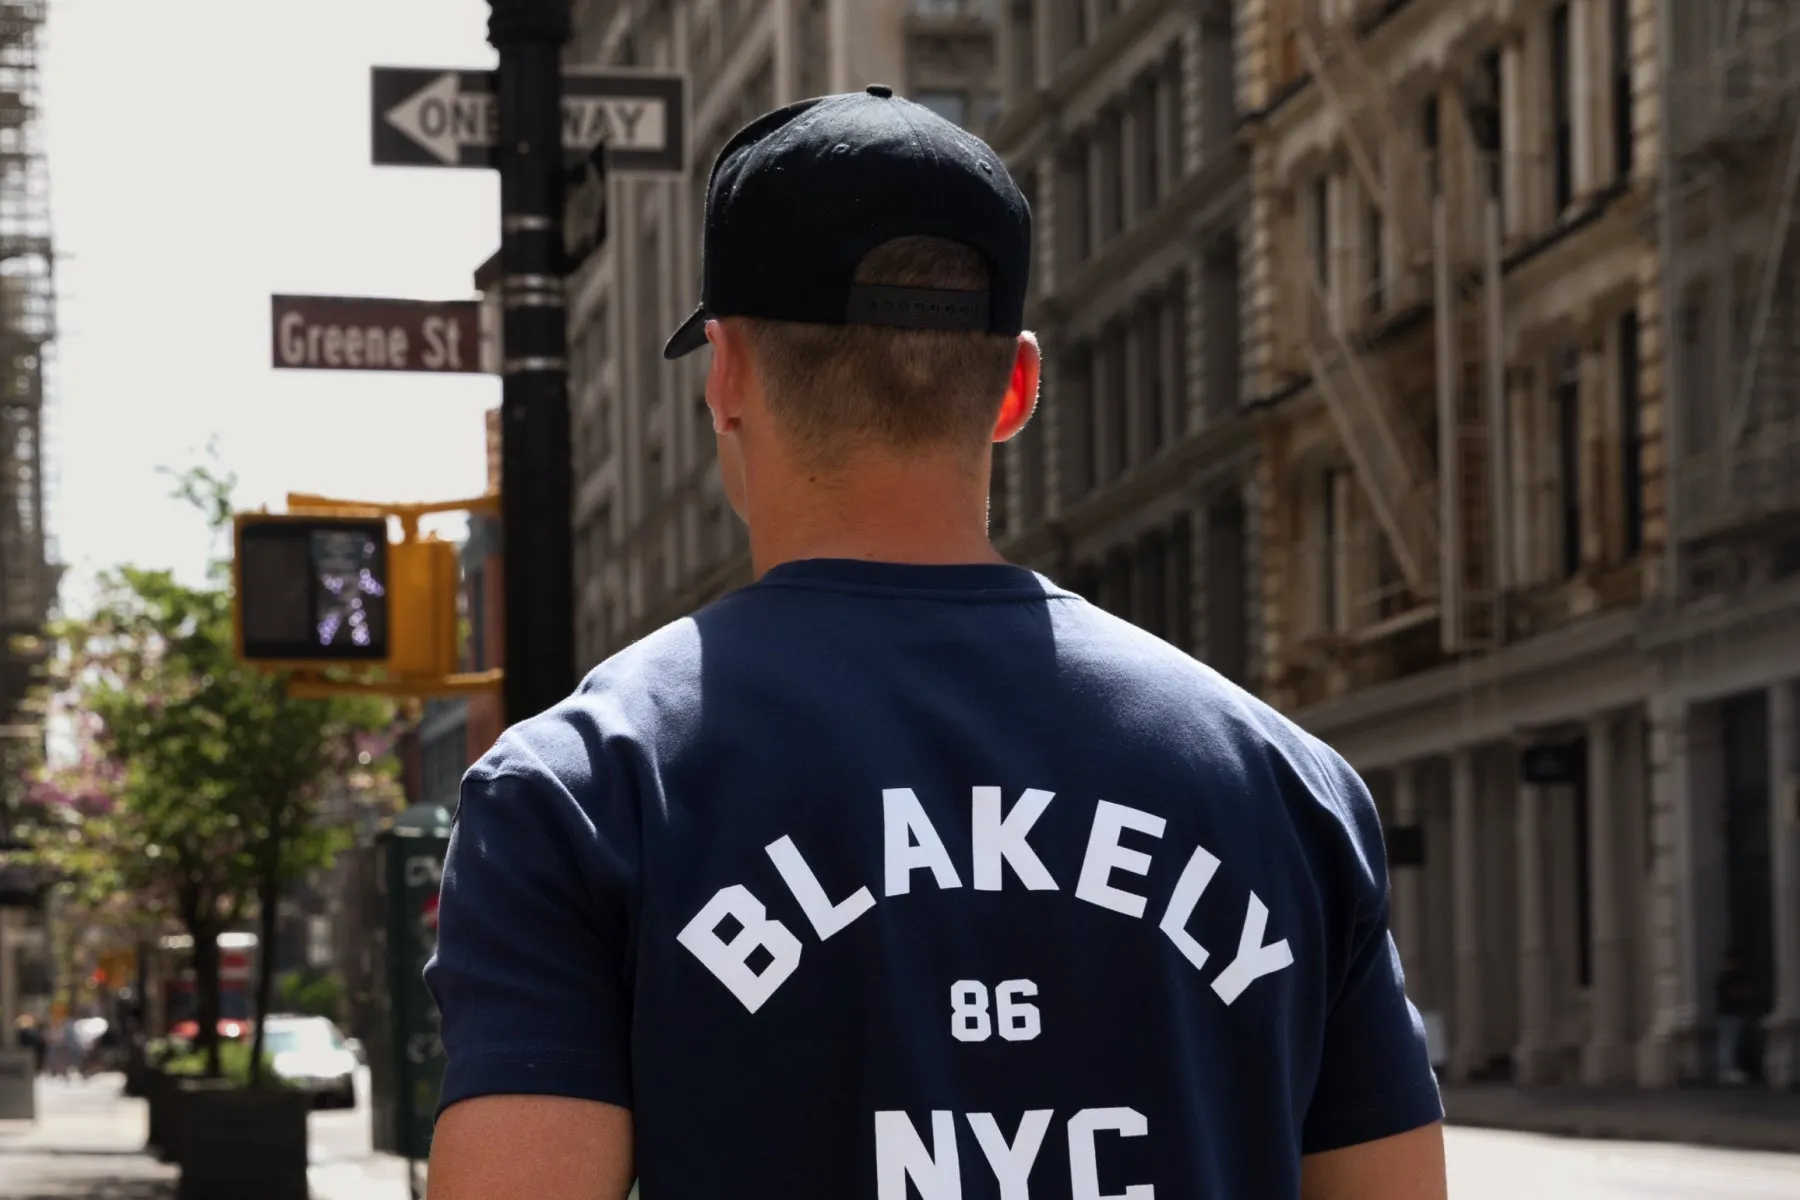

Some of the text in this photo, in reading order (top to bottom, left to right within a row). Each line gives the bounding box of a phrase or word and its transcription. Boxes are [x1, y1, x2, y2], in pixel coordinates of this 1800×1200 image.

[280, 311, 463, 369] Greene St
[677, 786, 1293, 1014] BLAKELY
[950, 979, 1041, 1042] 86
